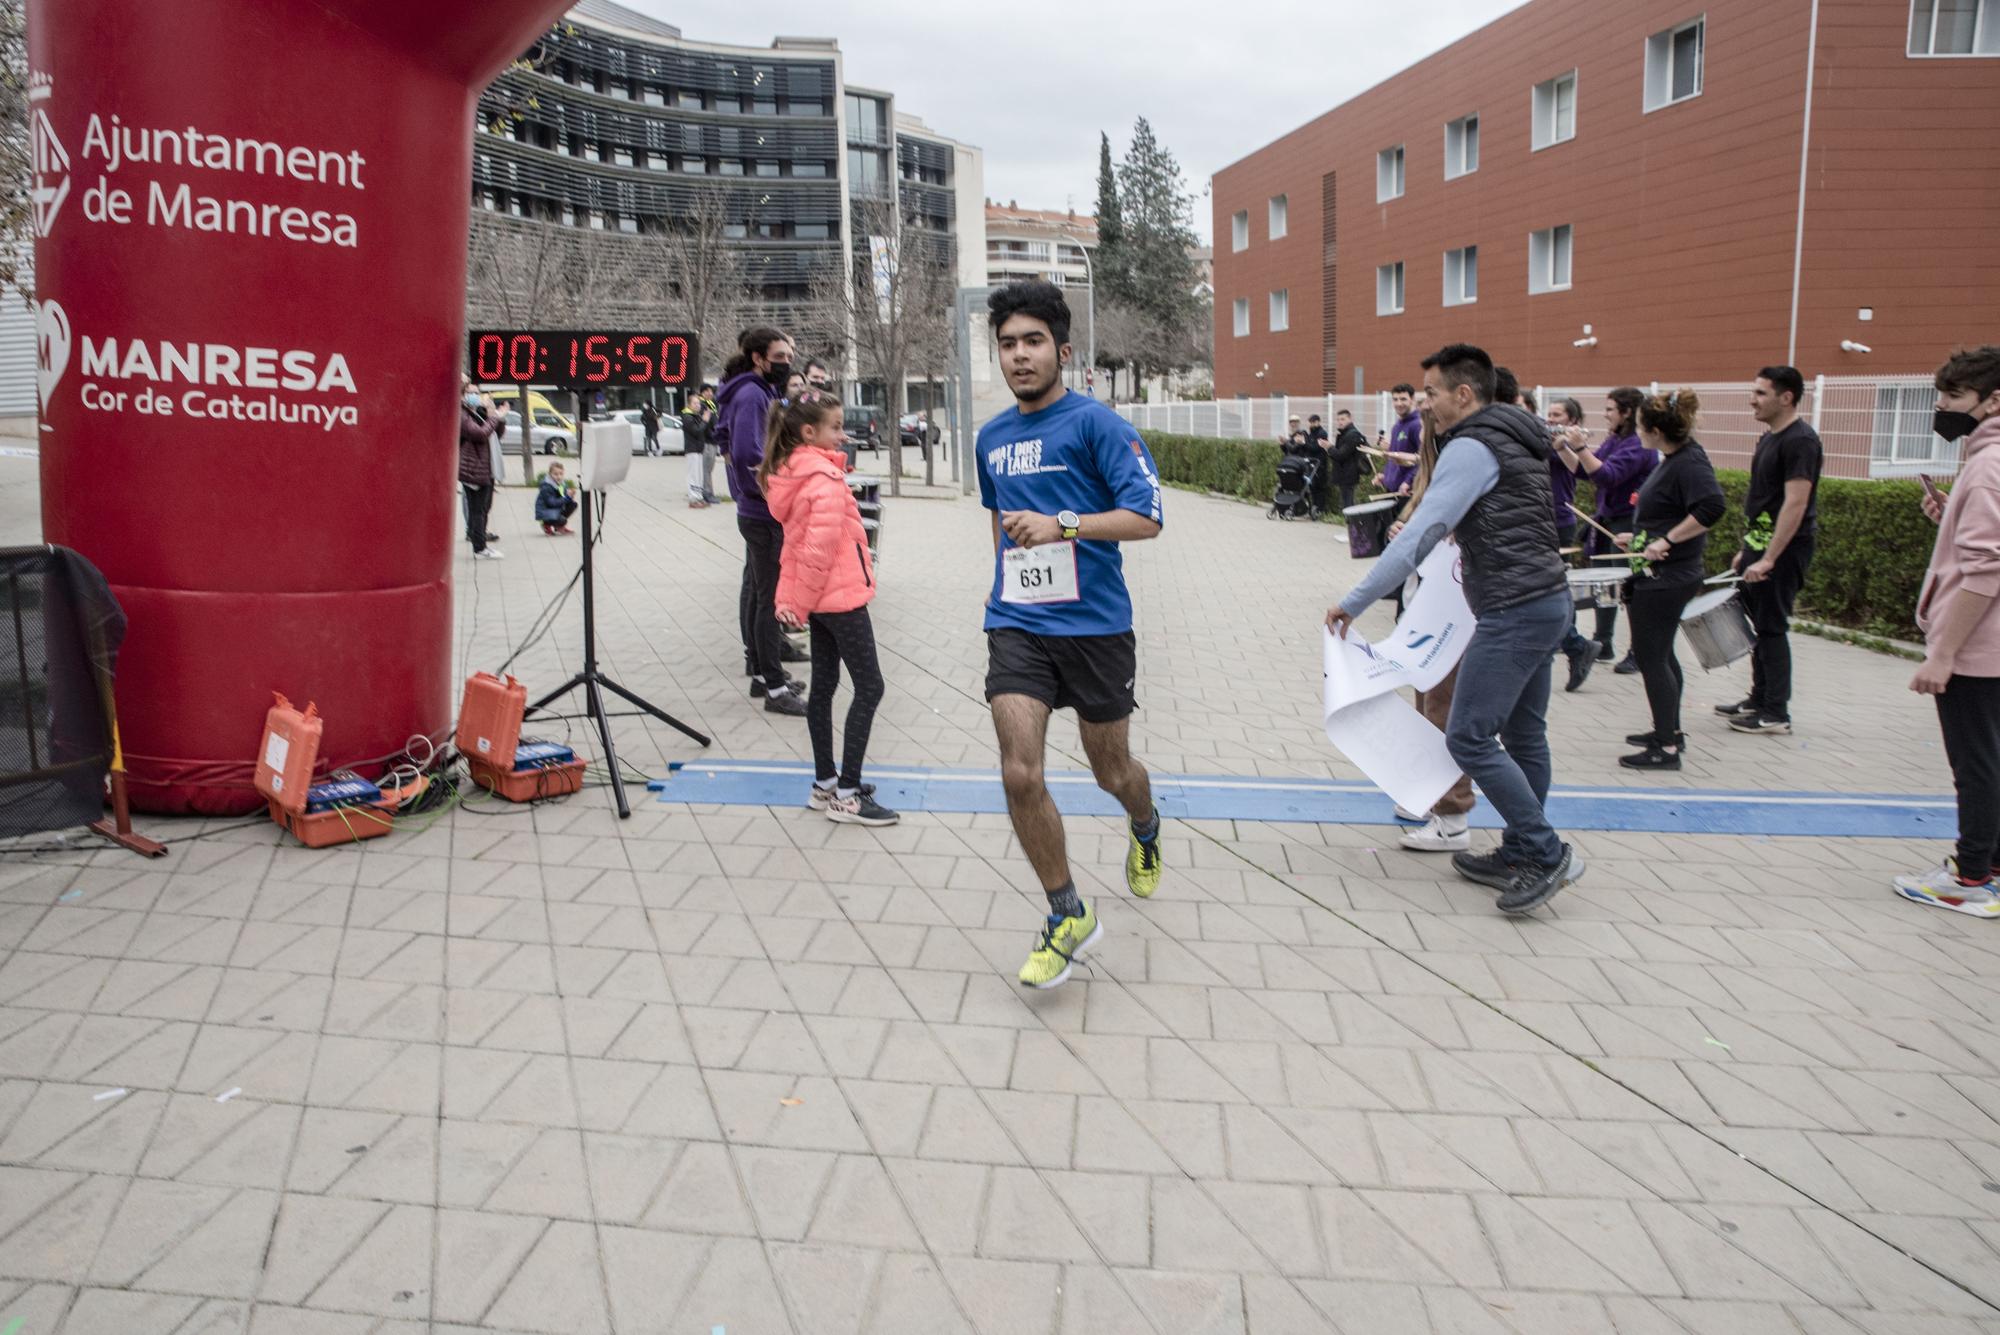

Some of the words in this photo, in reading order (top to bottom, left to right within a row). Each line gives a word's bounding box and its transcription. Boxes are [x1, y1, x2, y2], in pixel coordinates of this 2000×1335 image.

[82, 113, 366, 190] Ajuntament
[82, 175, 134, 224] de
[147, 180, 358, 248] Manresa
[81, 335, 358, 394] MANRESA
[477, 335, 689, 383] 00:15:50
[80, 383, 128, 412] Cor
[134, 388, 174, 416] de
[181, 390, 358, 432] Catalunya
[1020, 565, 1053, 588] 631
